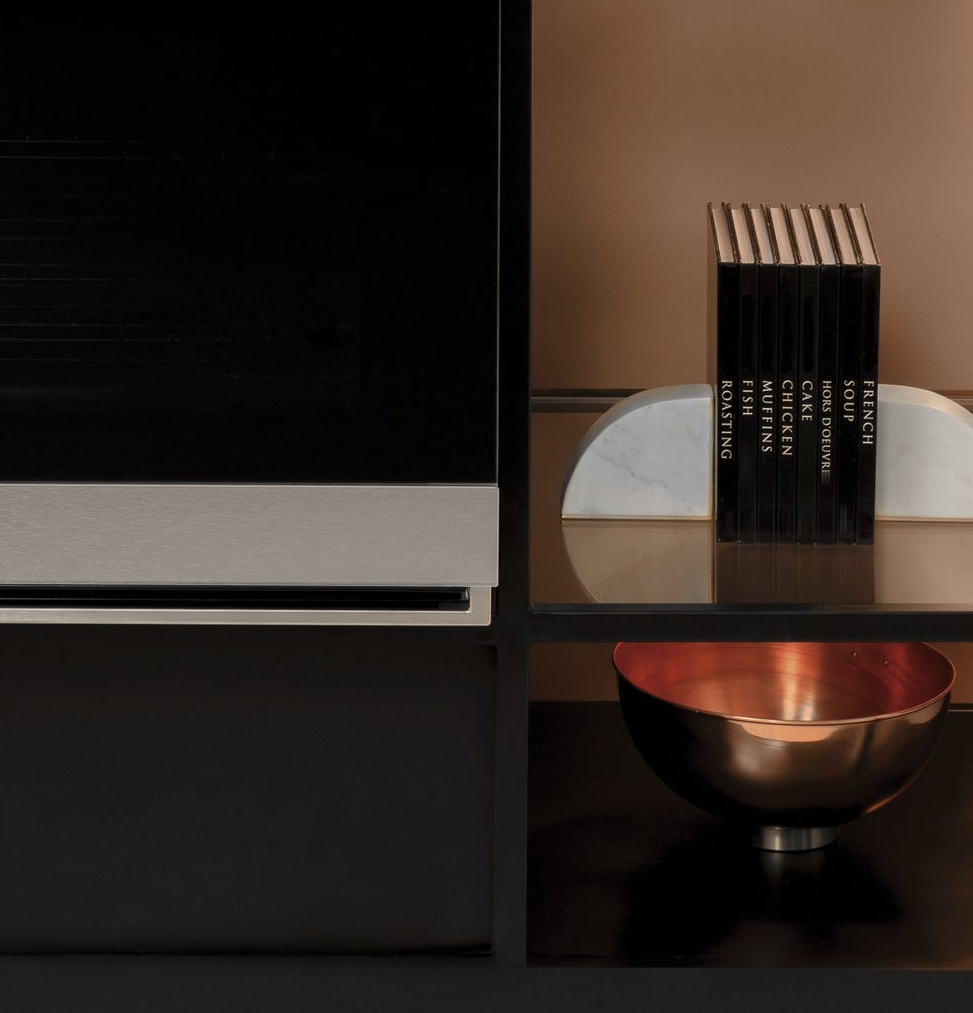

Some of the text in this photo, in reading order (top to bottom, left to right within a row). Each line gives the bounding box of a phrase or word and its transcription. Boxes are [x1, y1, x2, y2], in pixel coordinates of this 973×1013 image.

[721, 381, 732, 458] ROASTING
[743, 381, 753, 415] FISH
[762, 381, 773, 452] MUFFINS
[782, 380, 793, 455] CHICKEN
[802, 381, 813, 420] CAKE
[822, 381, 831, 412] HORS
[844, 380, 855, 421] SOUP
[863, 381, 874, 444] FRENCH
